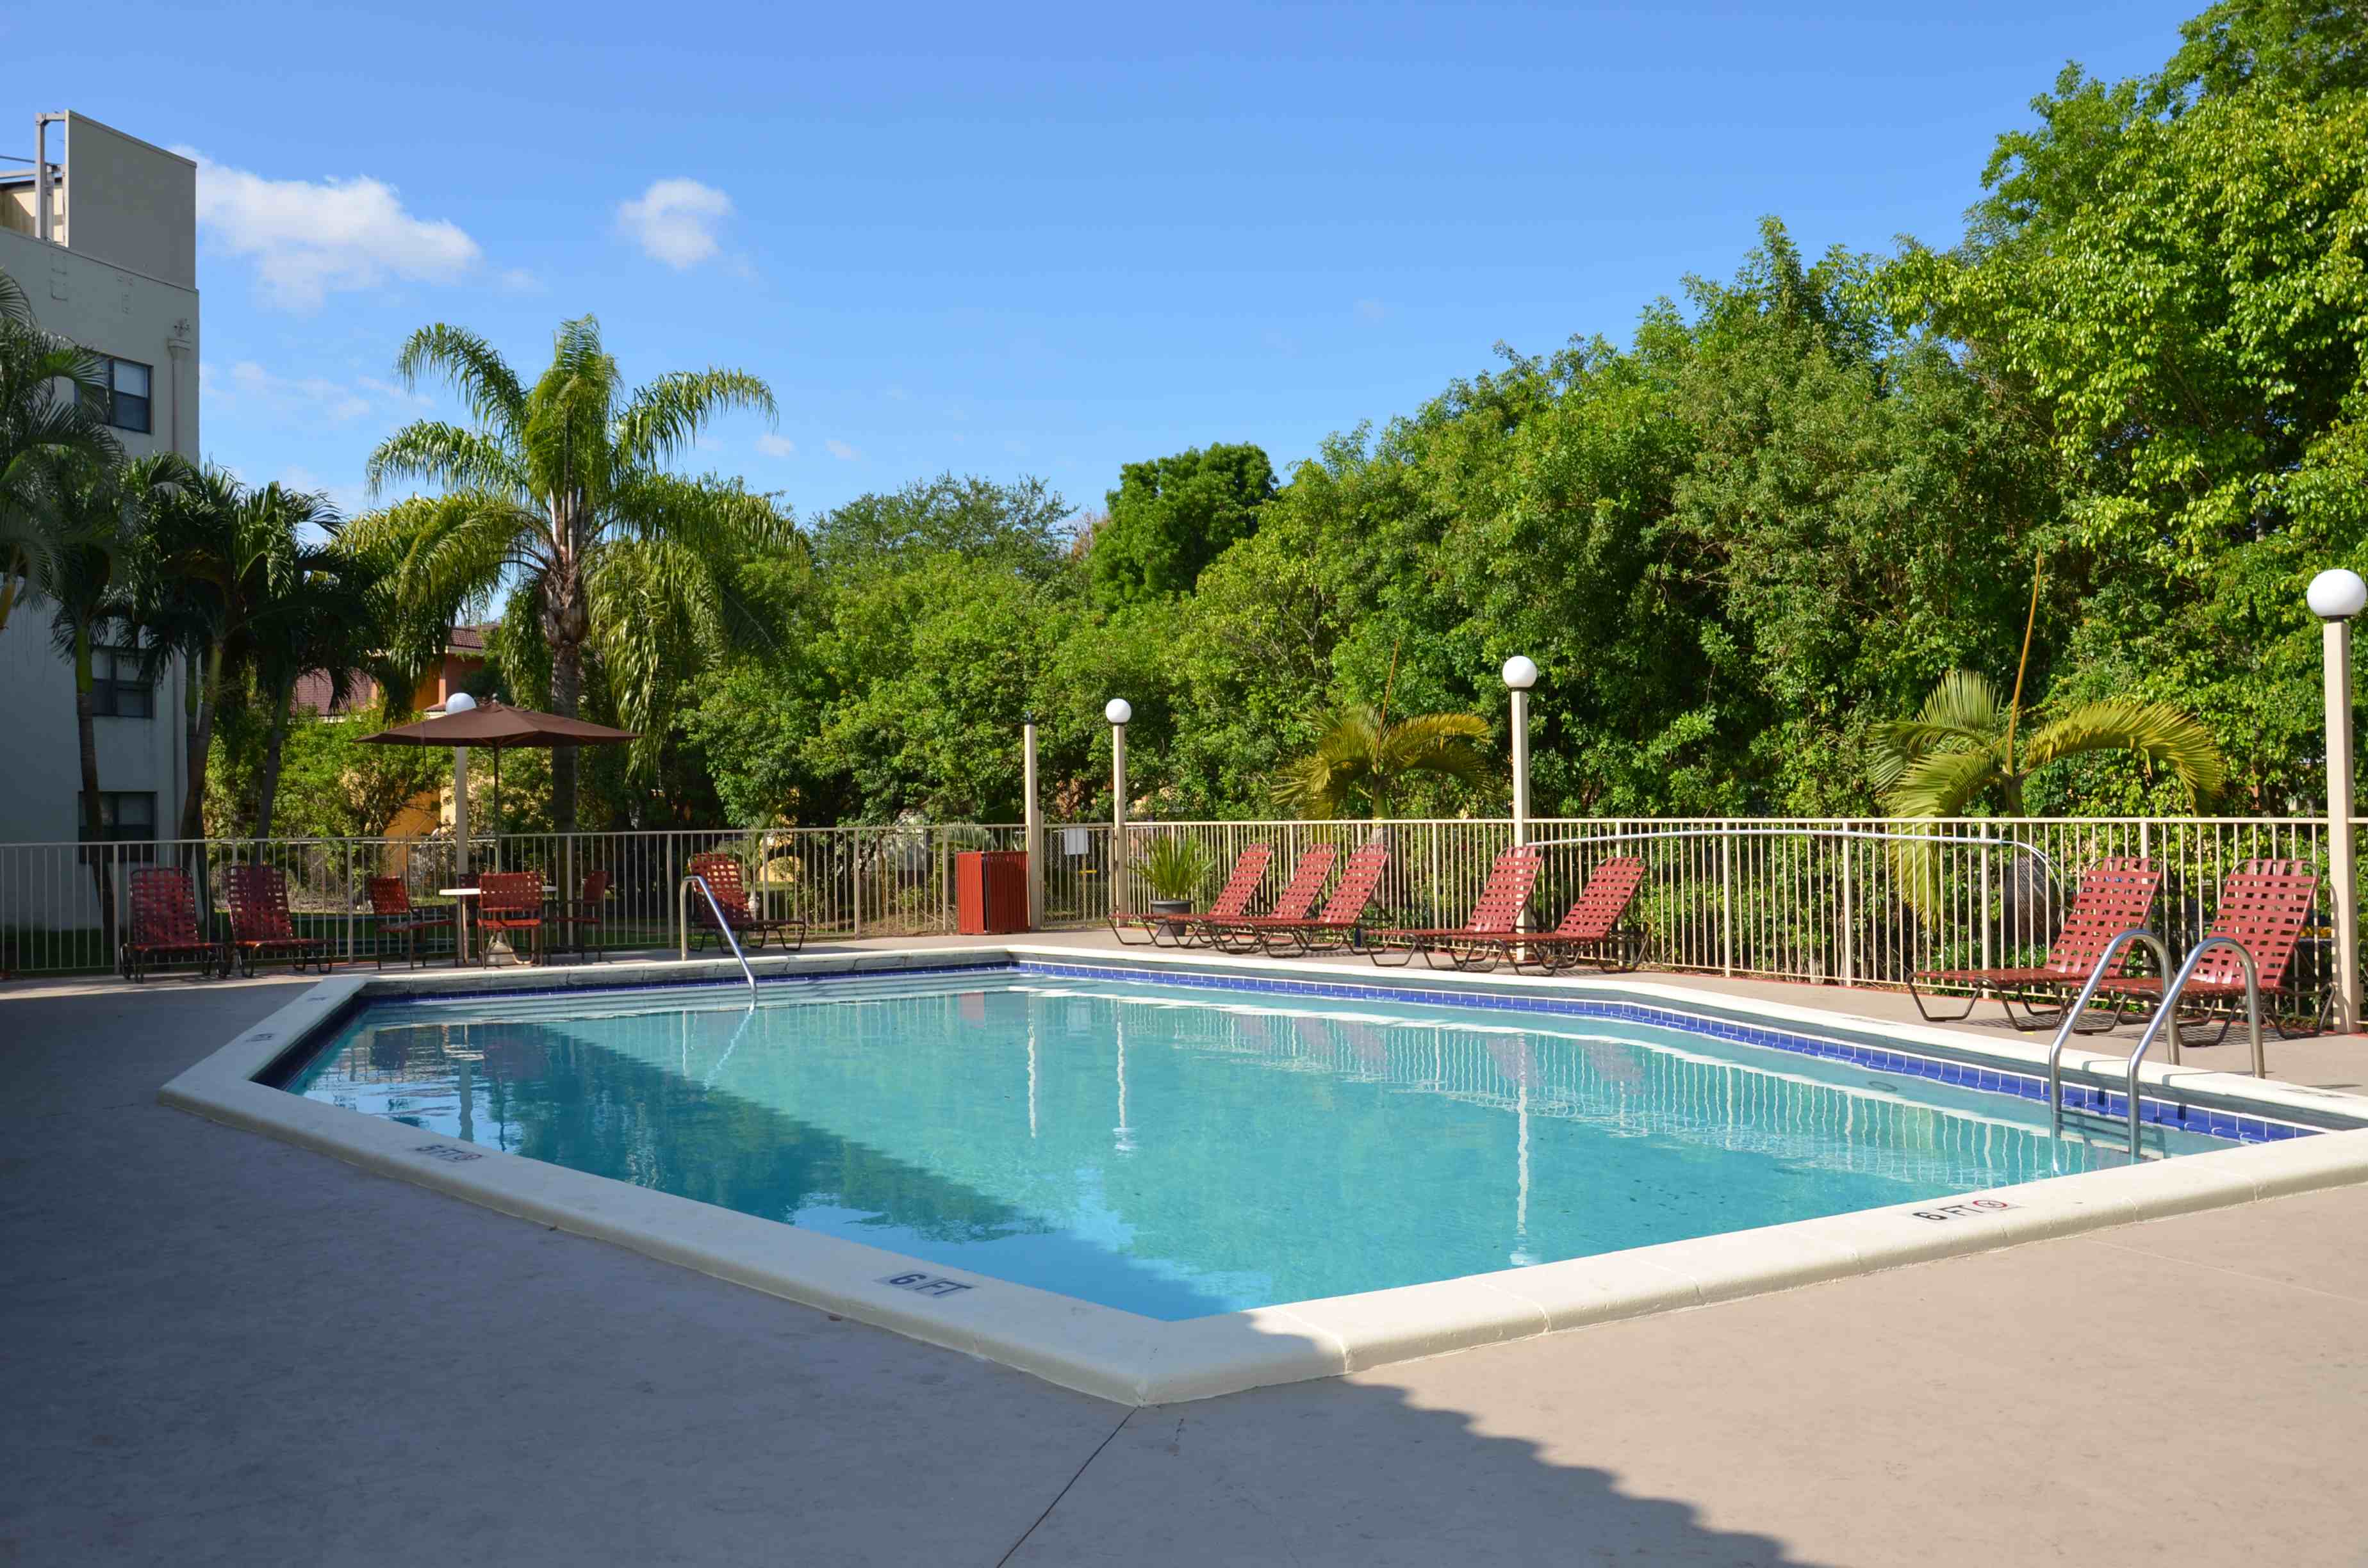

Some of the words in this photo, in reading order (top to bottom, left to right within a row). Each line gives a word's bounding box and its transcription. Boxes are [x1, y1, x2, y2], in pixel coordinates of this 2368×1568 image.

[1912, 1212, 1948, 1221] 6
[1937, 1205, 1984, 1216] FT
[889, 1273, 927, 1285] 6
[914, 1280, 973, 1295] FT
